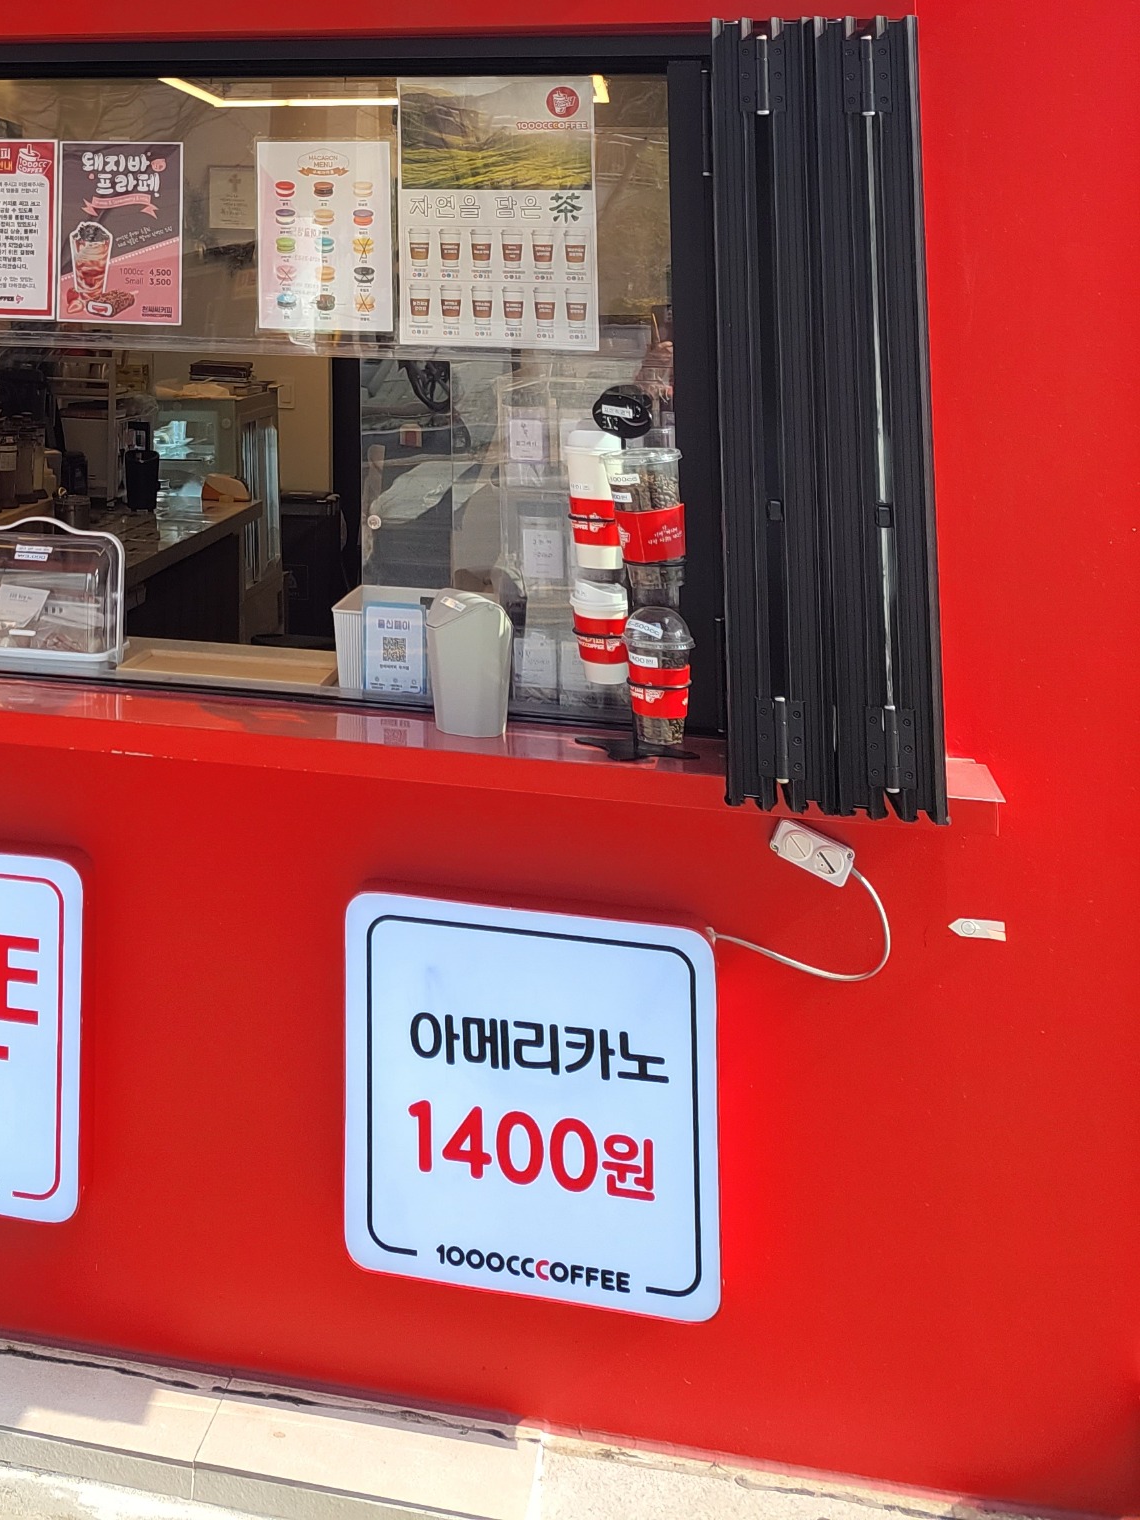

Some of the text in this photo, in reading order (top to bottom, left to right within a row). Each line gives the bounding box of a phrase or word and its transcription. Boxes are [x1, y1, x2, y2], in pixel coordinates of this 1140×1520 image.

[81, 151, 150, 172] 돼지바
[410, 192, 583, 224] 자연을 담은 茶
[119, 267, 172, 277] 1000cc 4,500
[125, 277, 172, 286] Small 3,500
[409, 1011, 670, 1085] 아메리카노
[407, 1098, 656, 1203] 1400원
[435, 1242, 631, 1294] 1000CCCOFFEE
